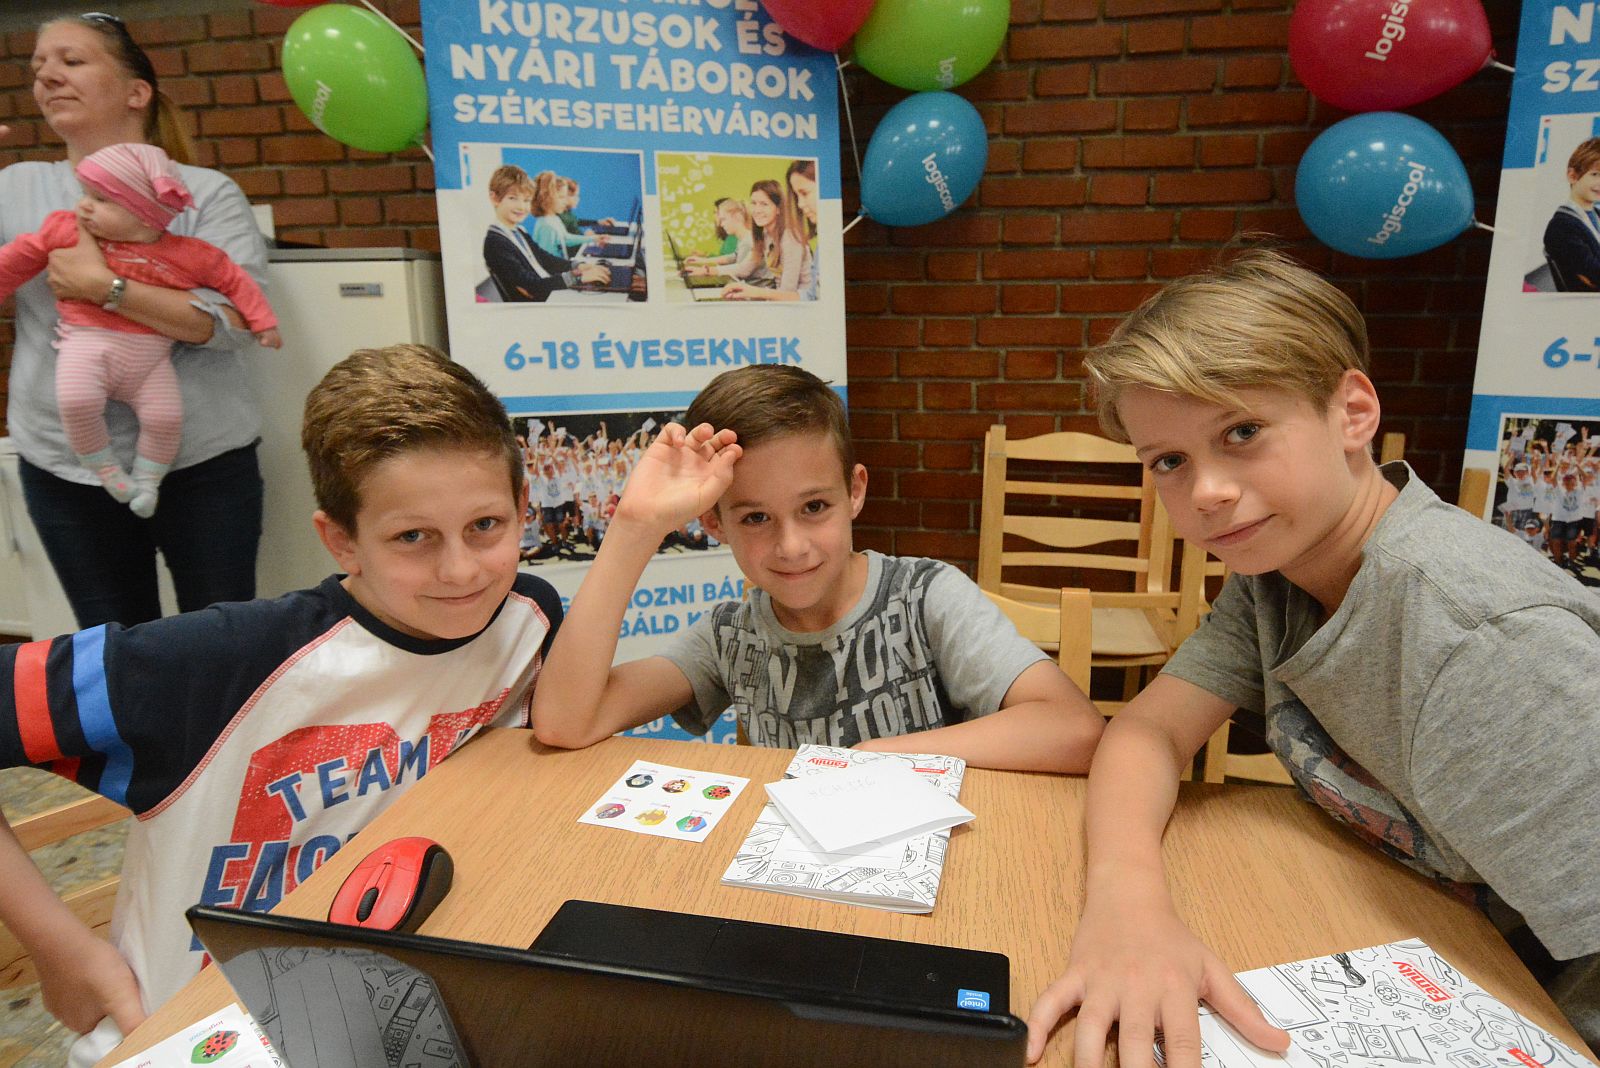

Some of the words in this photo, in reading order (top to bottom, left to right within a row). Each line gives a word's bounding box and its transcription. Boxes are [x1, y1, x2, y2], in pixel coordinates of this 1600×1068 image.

[479, 0, 722, 51] KURZUSOK
[736, 12, 786, 56] ÉS
[1364, 0, 1413, 61] logis
[450, 38, 595, 88] NYÁRI
[611, 49, 815, 102] TÁBOROK
[453, 89, 819, 140] SZÉKESFEHÉRVÁRON
[1367, 160, 1427, 245] logiscool
[504, 341, 581, 371] 6-18
[593, 333, 802, 369] ÉVESEKNEK
[820, 586, 928, 705] YORK
[267, 734, 432, 824] TEAM
[808, 757, 850, 769] Family
[963, 998, 984, 1009] intel
[1393, 961, 1453, 1003] Family
